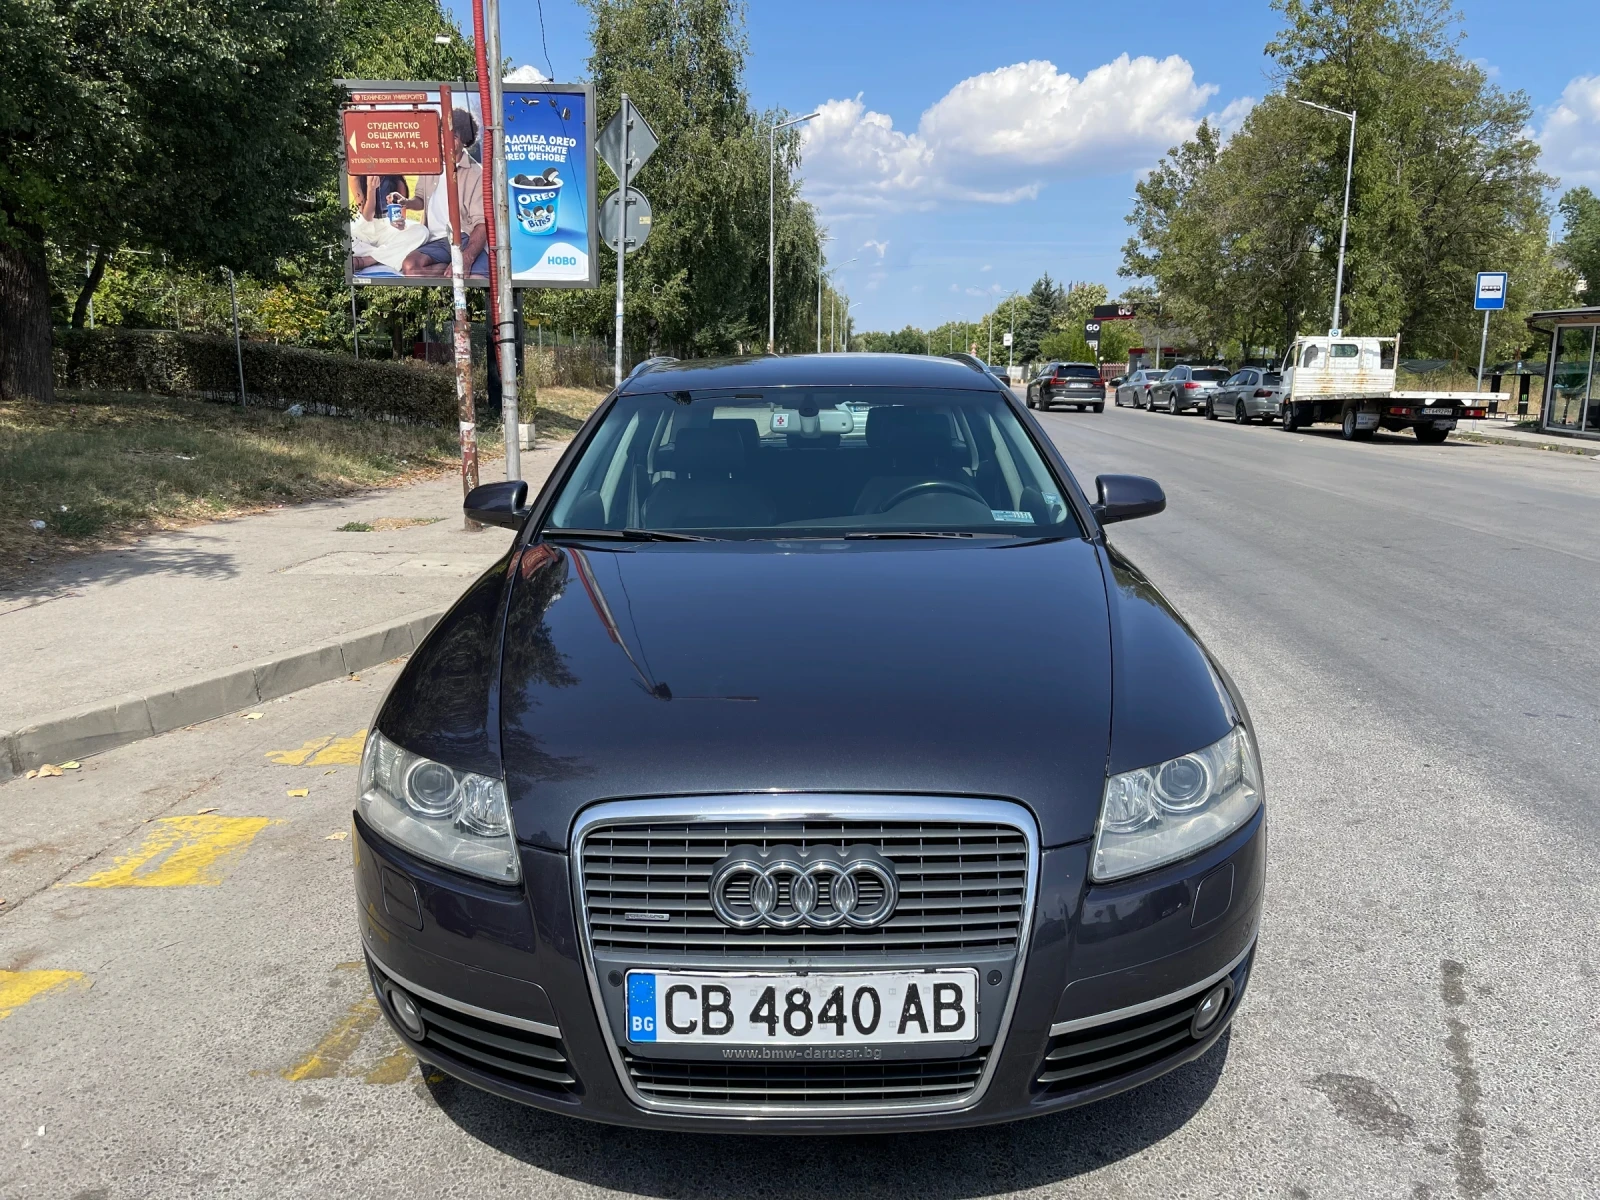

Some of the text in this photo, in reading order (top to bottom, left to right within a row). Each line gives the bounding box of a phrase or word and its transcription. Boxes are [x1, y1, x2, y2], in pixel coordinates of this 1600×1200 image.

[361, 93, 391, 101] ТЕХНИЧЕСКИ
[367, 122, 420, 130] СТУДЕНТСКО
[367, 132, 421, 140] ОБЩЕЖИТИЕ
[505, 134, 576, 147] АДОЛЕД OREO
[360, 141, 380, 149] блок
[394, 141, 406, 149] 13,
[407, 141, 418, 149] 14,
[420, 141, 429, 149] 16
[511, 144, 568, 154] ИСТИНСКИТЕ
[528, 152, 566, 163] ФЕНОВЕ
[518, 191, 556, 204] OREO
[547, 256, 577, 266] НОВО
[665, 982, 966, 1036] CB 4840 AB
[632, 1016, 654, 1032] BG
[722, 1046, 882, 1060] www.bmw-darucar.bg
